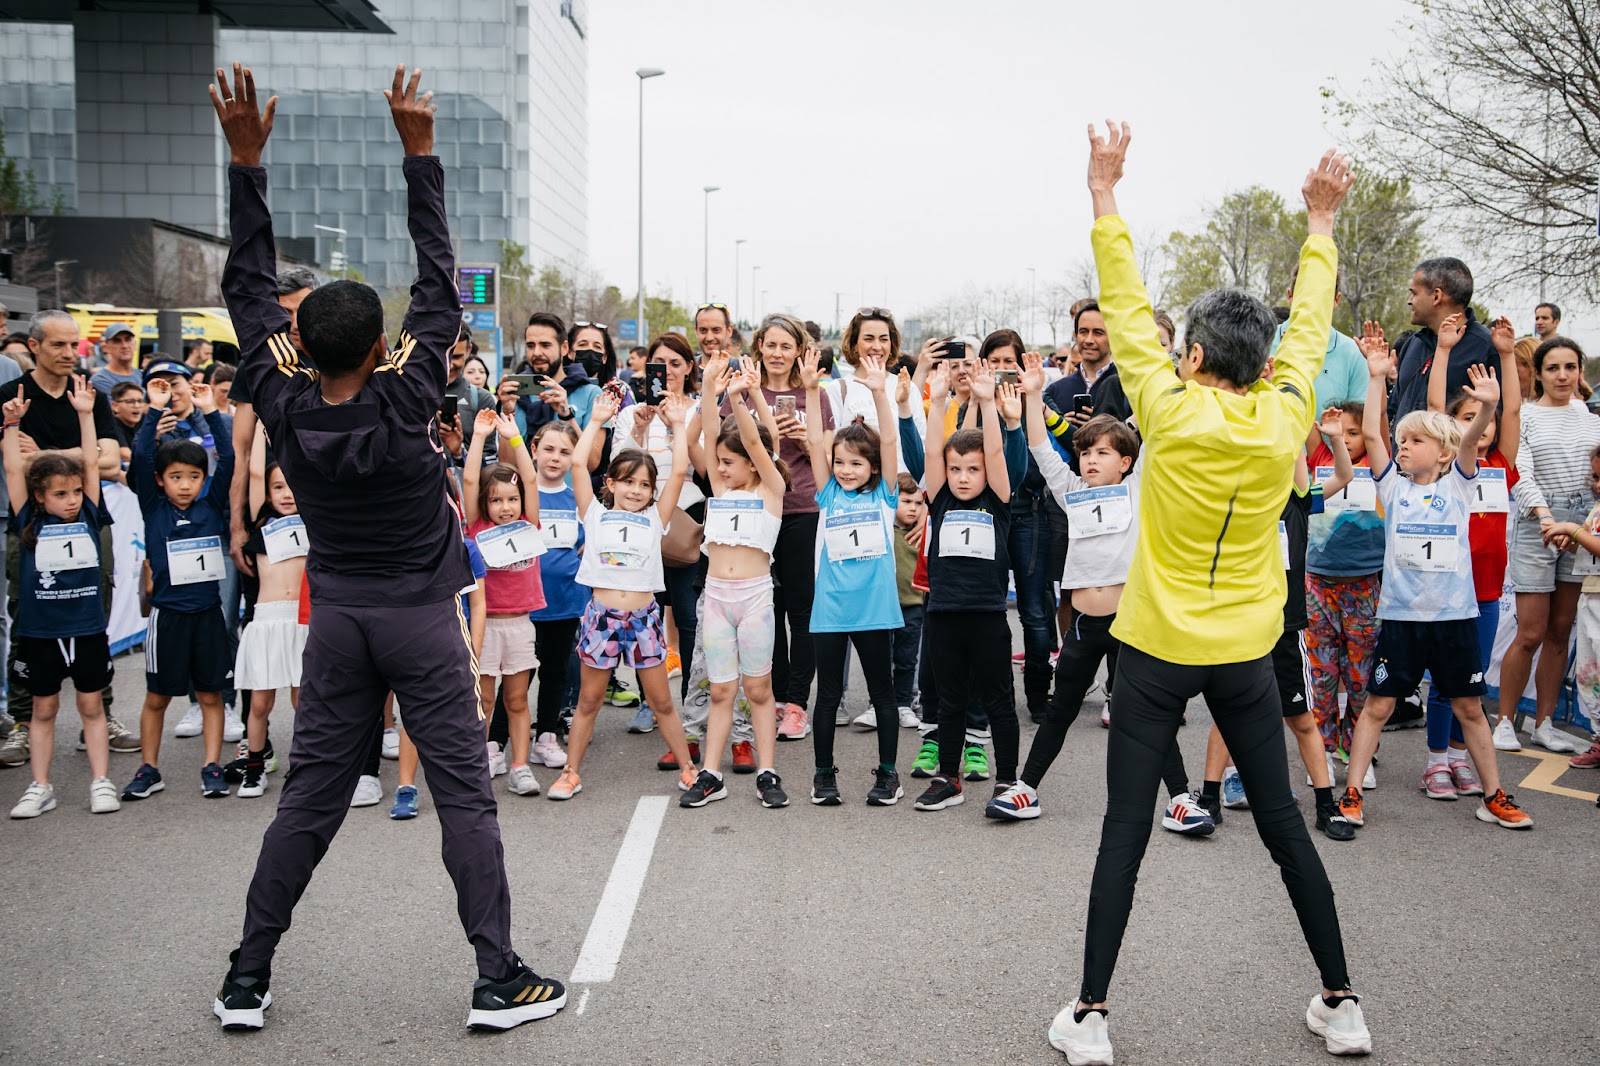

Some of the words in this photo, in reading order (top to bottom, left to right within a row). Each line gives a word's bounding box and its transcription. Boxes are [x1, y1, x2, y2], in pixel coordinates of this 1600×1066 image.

[1476, 484, 1483, 502] 1
[1092, 504, 1102, 523] 1
[548, 524, 558, 538] 1
[730, 514, 739, 532] 1
[1398, 524, 1426, 532] ProFuturo
[290, 530, 300, 546] 1
[618, 526, 628, 542] 1
[849, 529, 859, 547] 1
[960, 527, 970, 546] 1
[63, 540, 73, 558] 1
[505, 538, 518, 553] 1
[1422, 541, 1432, 560] 1
[196, 554, 206, 571] 1
